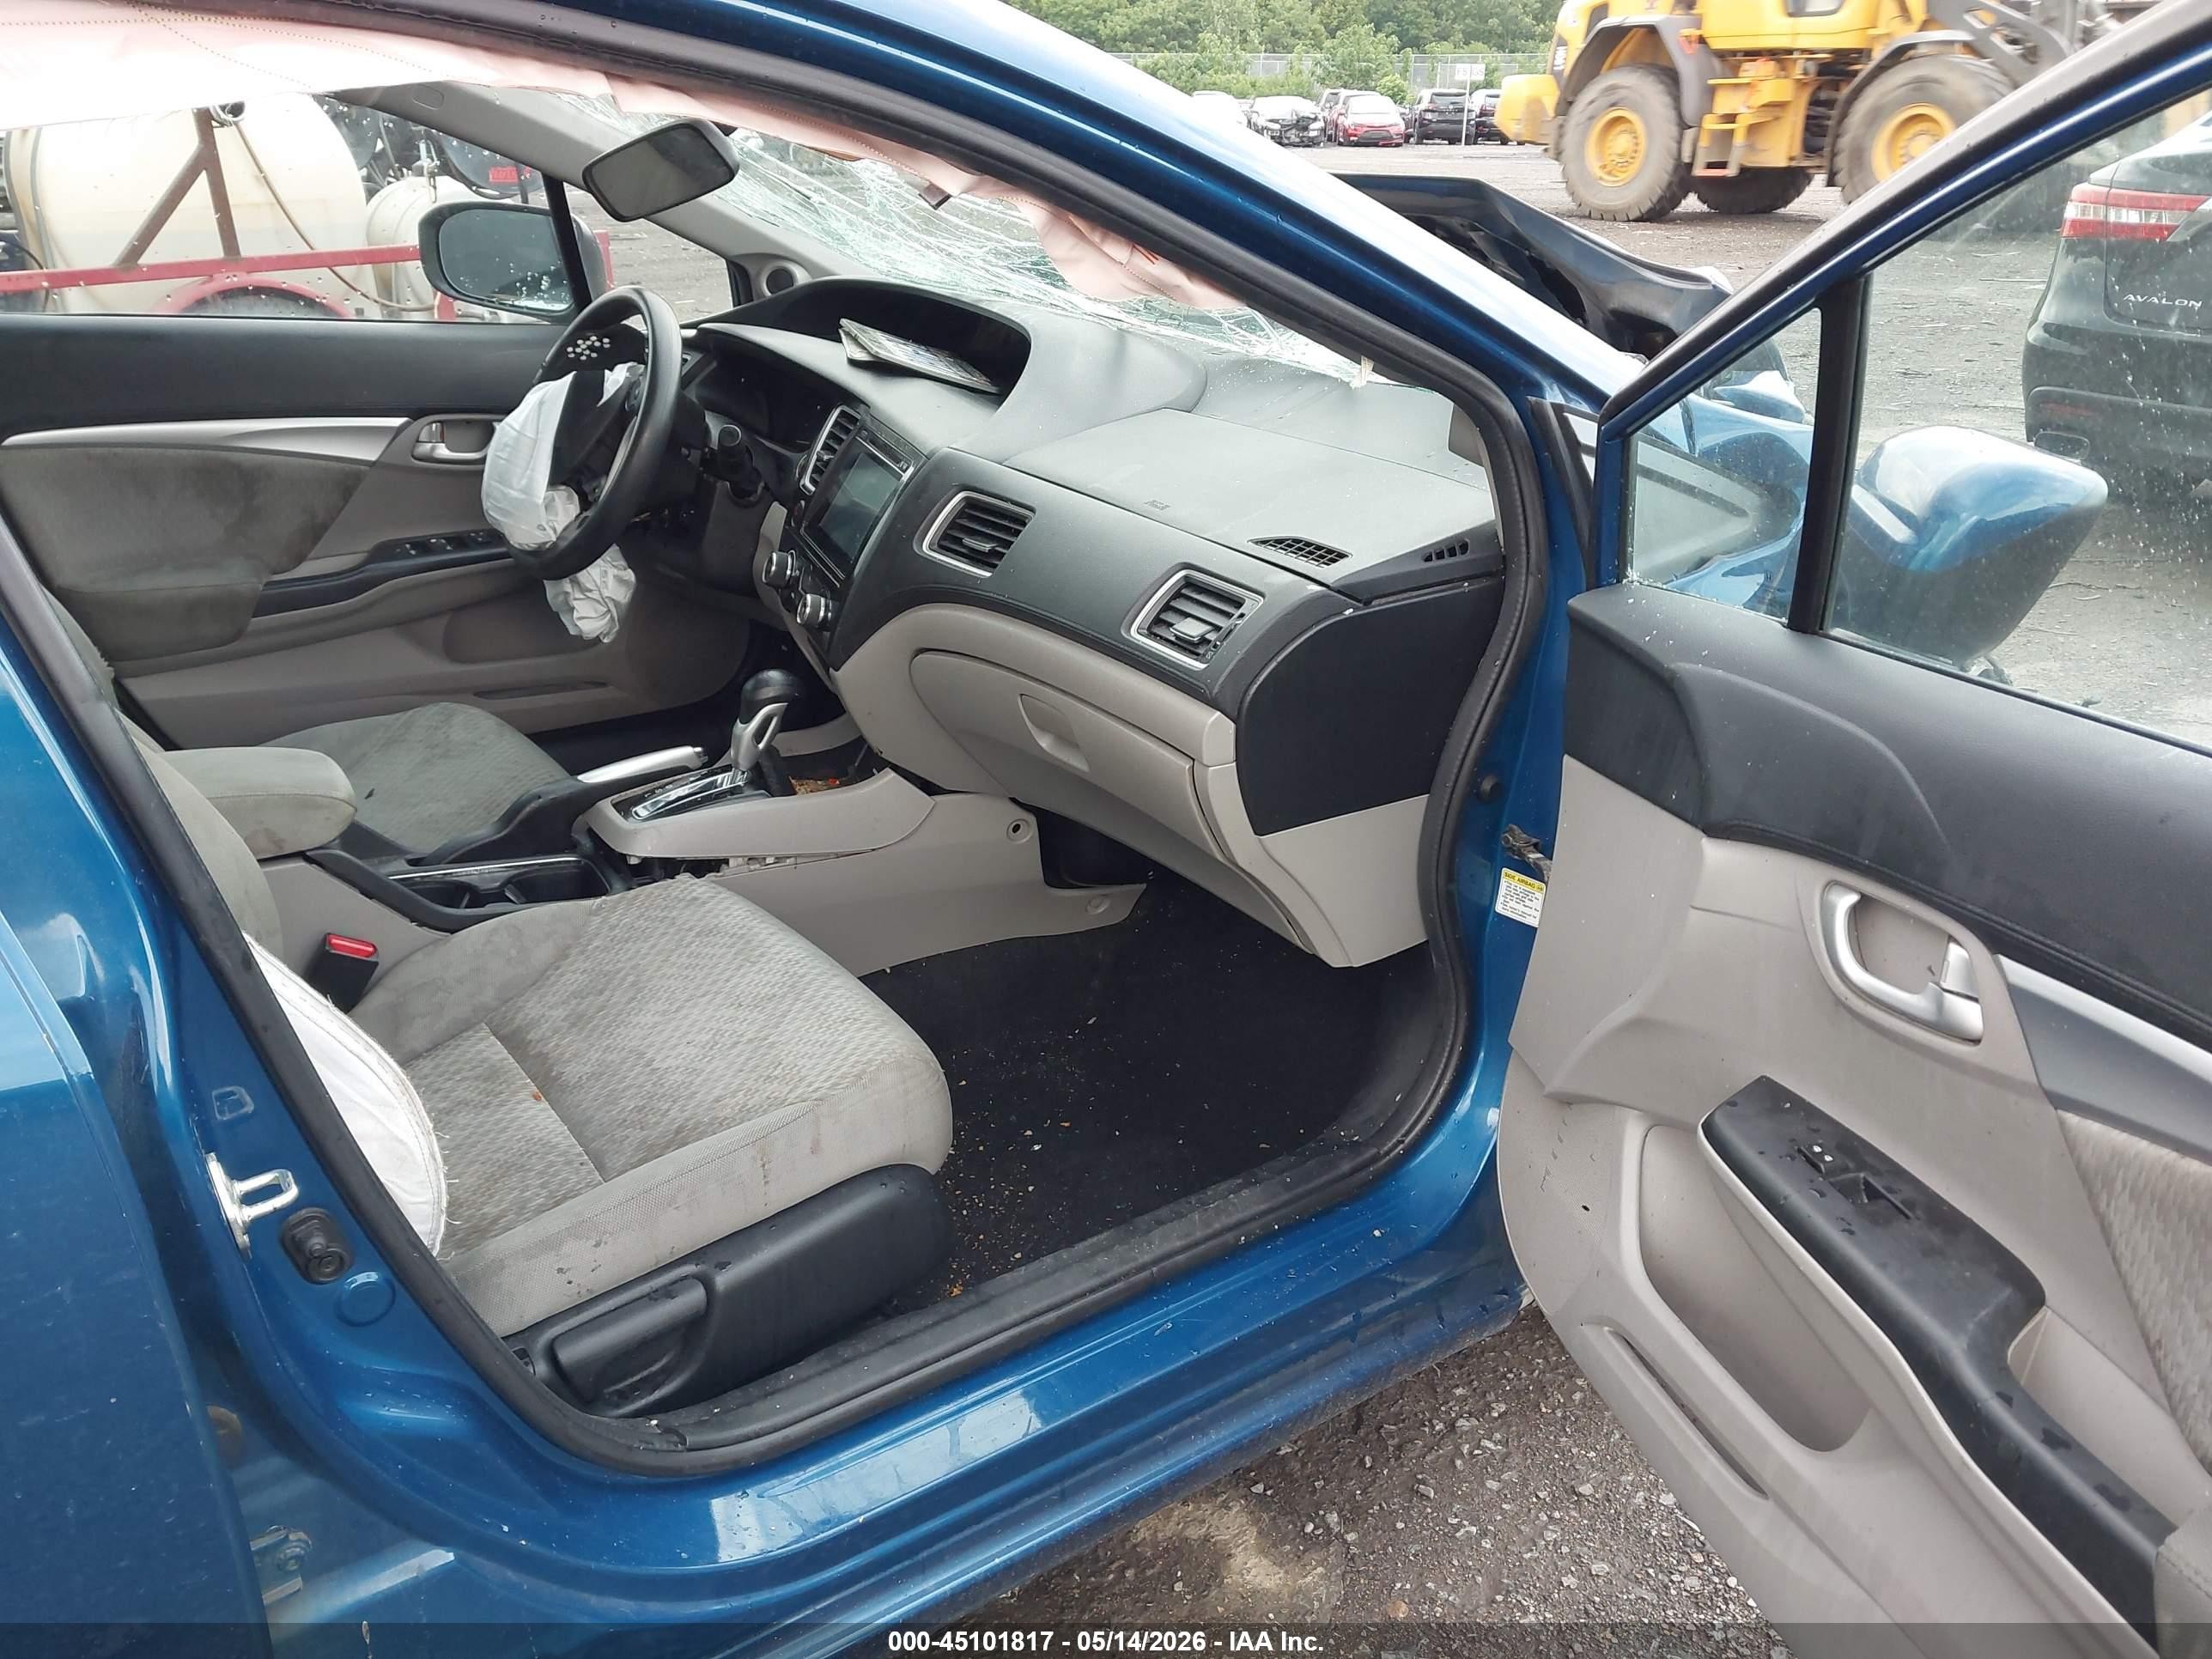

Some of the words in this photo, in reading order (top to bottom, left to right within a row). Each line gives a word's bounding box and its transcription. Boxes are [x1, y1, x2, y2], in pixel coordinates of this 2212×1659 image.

[2123, 294, 2203, 307] AVALON
[1504, 872, 1516, 881] SIDE
[1516, 878, 1536, 889] AIRBAG
